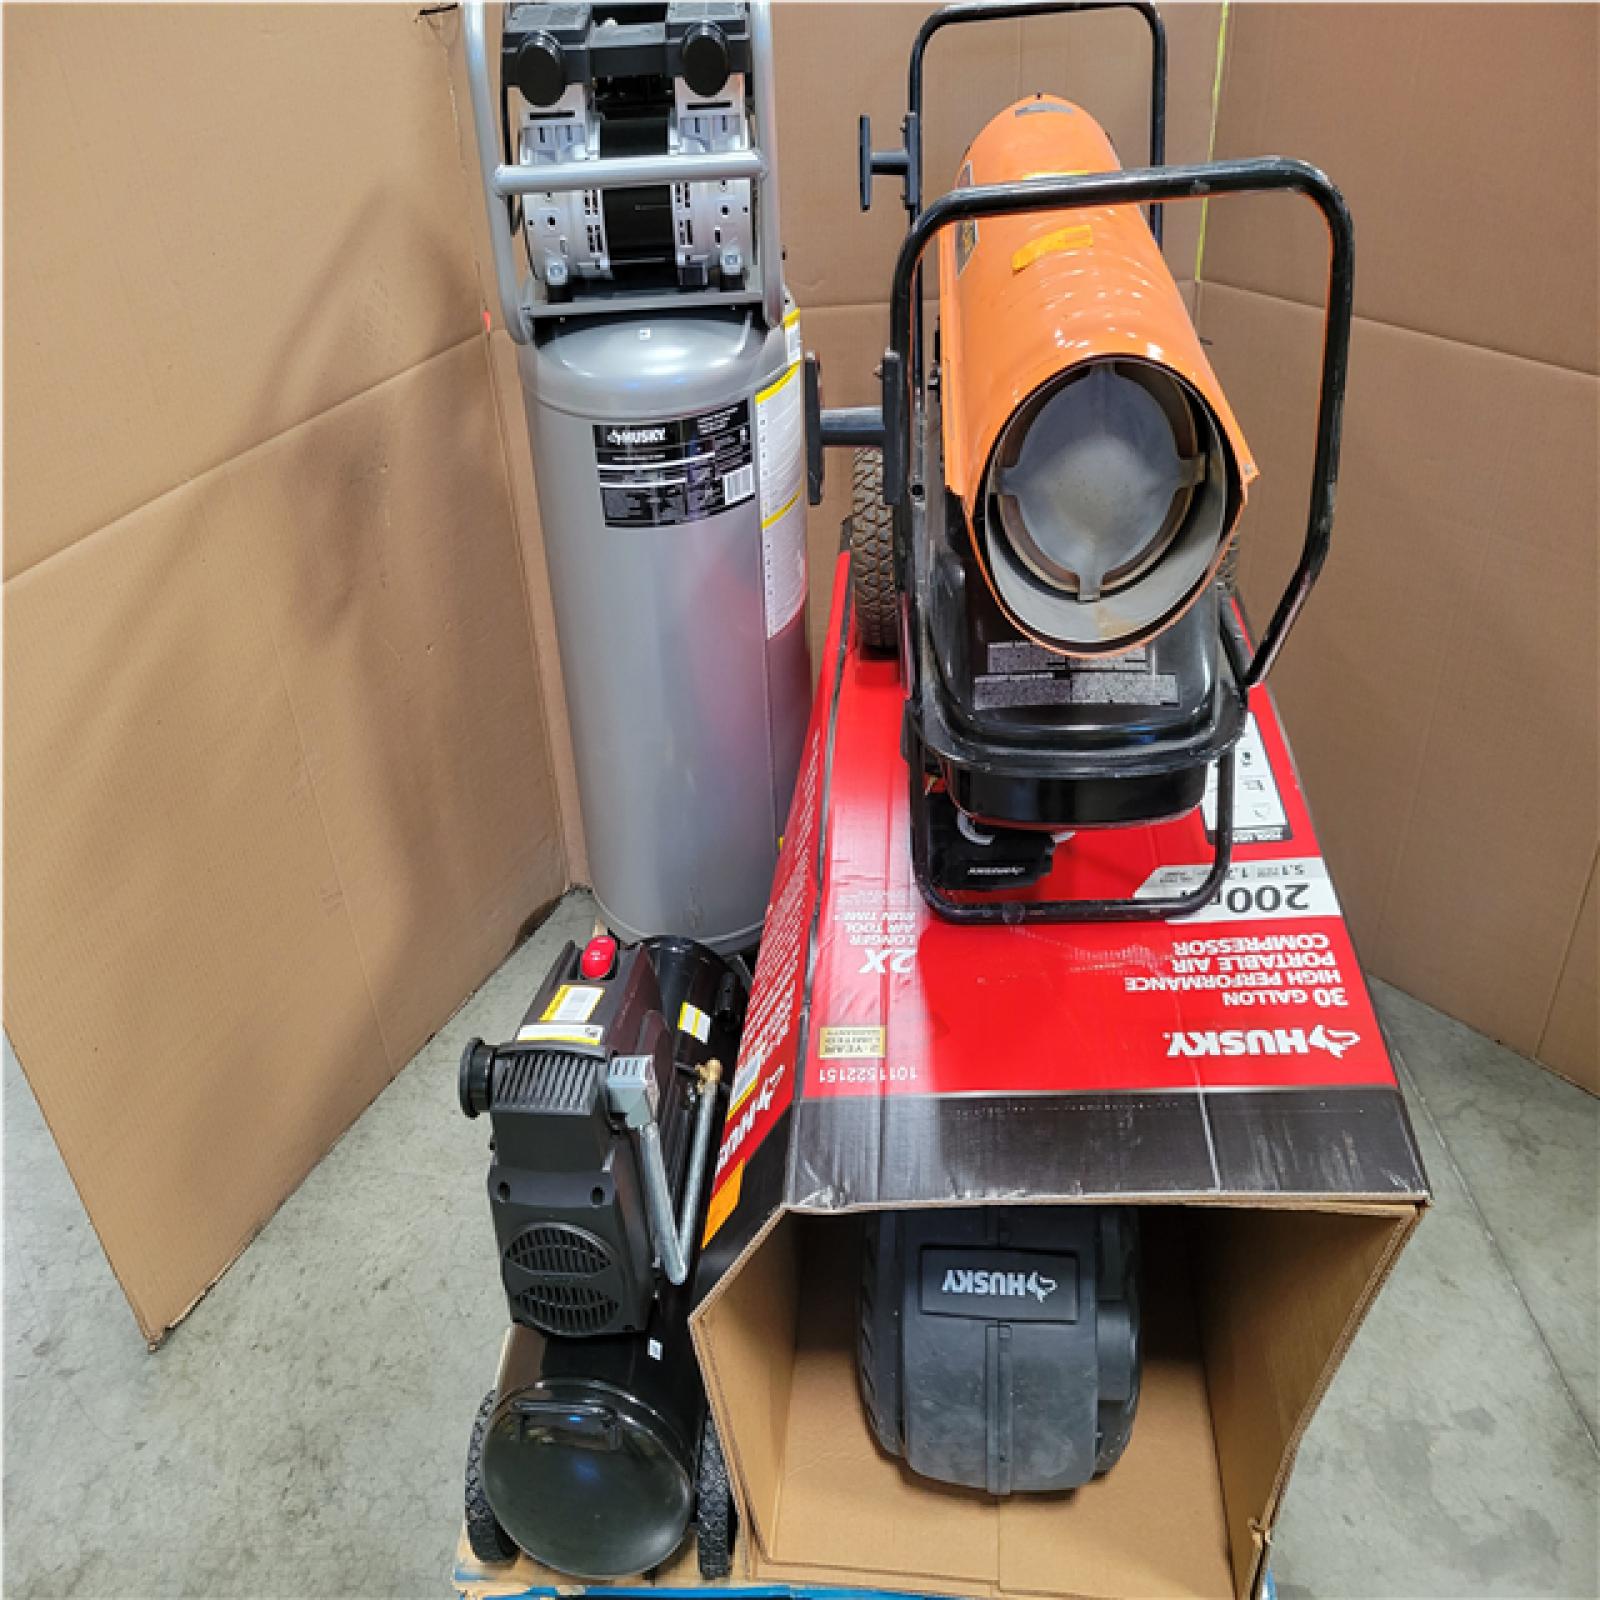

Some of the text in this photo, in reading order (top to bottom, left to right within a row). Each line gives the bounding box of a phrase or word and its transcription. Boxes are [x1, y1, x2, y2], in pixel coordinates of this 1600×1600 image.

[624, 427, 666, 443] HUSKY
[1226, 884, 1309, 913] 200
[850, 935, 916, 946] LONGER
[1173, 933, 1329, 956] COMPRESSOR
[859, 949, 916, 974] 2X
[1172, 952, 1336, 973] PORTABLE AIR
[1124, 970, 1342, 991] HIGH PERFORMANCE
[1222, 988, 1348, 1007] 30 GALLON
[1165, 1029, 1309, 1057] HUSKY
[819, 1065, 918, 1083] 1011522151
[942, 1269, 1026, 1296] HUSKY
